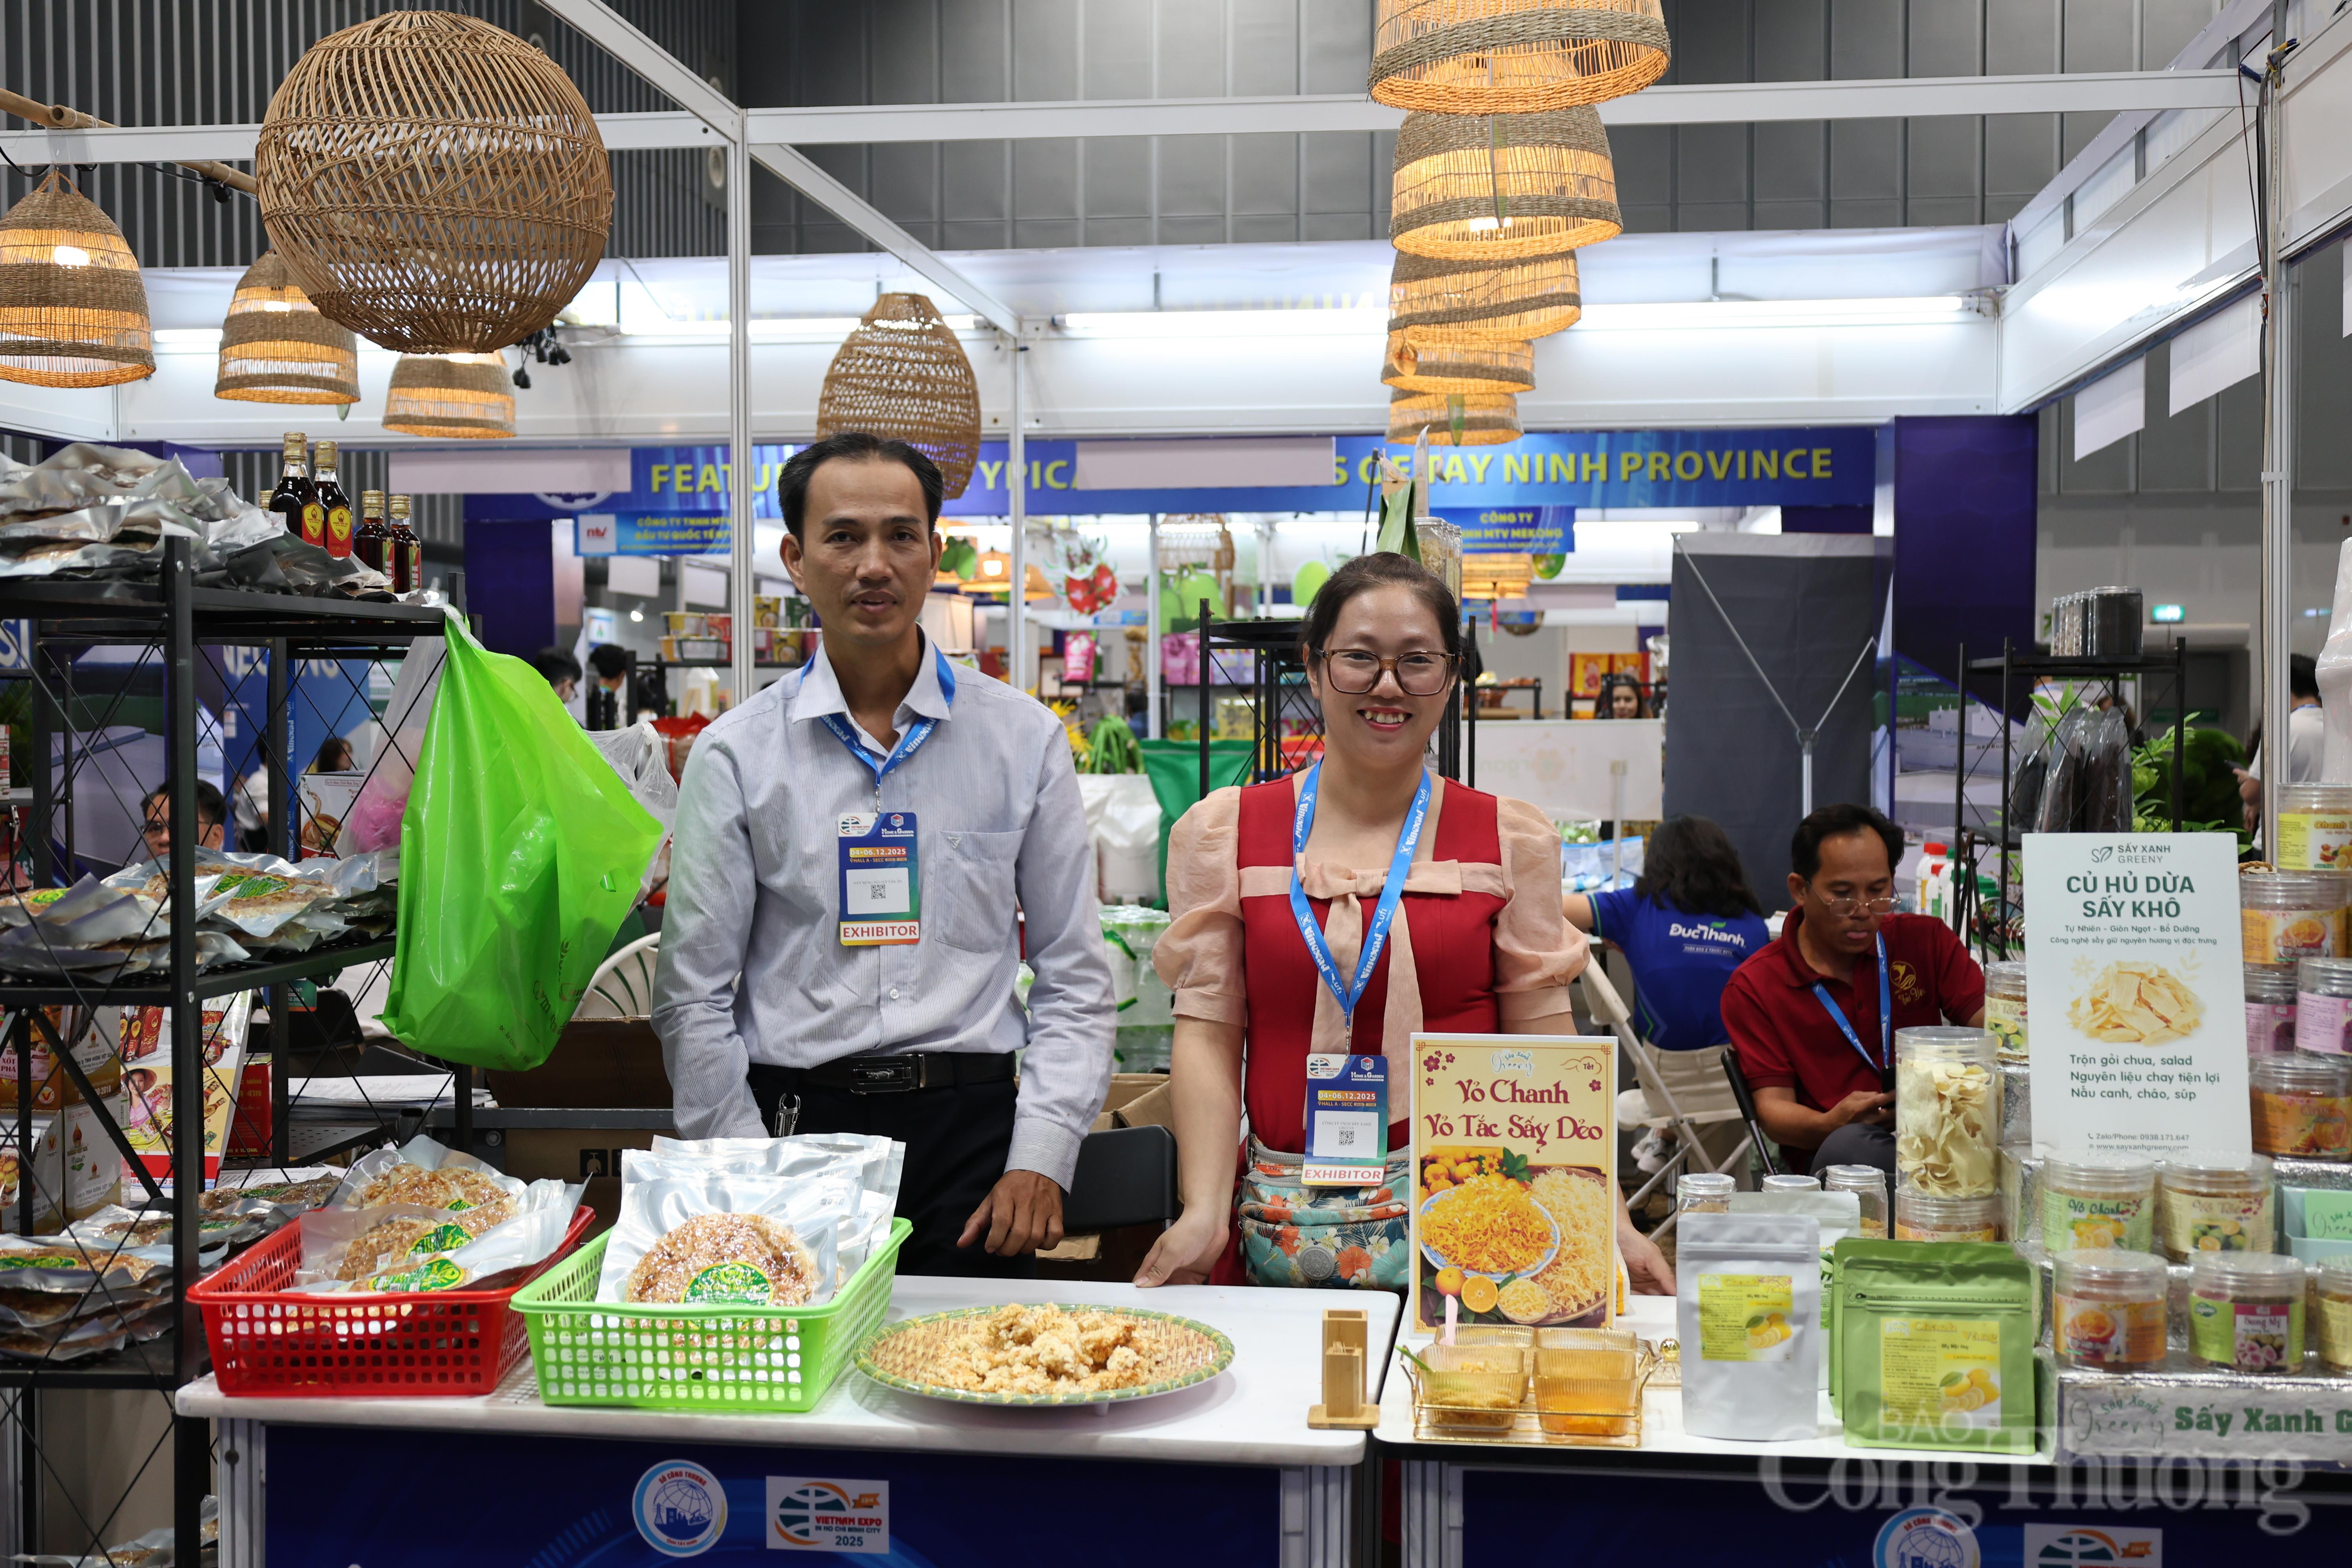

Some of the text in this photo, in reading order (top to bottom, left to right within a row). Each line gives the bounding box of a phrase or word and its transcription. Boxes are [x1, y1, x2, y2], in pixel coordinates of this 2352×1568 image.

[1504, 452, 1607, 483] NINH
[1621, 448, 1833, 481] PROVINCE
[1405, 809, 1424, 846] Vinexad
[2118, 842, 2171, 853] SẤY XANH
[2067, 871, 2195, 893] CỦ HỦ DỪA
[2083, 894, 2181, 918] SẤY KHÔ
[843, 925, 917, 938] EXHIBITOR
[2065, 925, 2075, 934] Tự
[2110, 924, 2129, 933] Giòn
[2132, 925, 2151, 935] Ngọt
[2160, 923, 2171, 933] Bổ
[2173, 924, 2200, 934] Dưỡng
[2050, 936, 2069, 946] Công
[2071, 937, 2089, 946] nghệ
[2120, 937, 2147, 945] nguyên
[2149, 936, 2172, 946] hương
[2198, 937, 2217, 946] trưng
[1304, 925, 1330, 972] Vinexad
[1360, 933, 1383, 978] Vinexad
[2070, 1053, 2192, 1067] Trộn gỏi chua, salad
[2071, 1071, 2220, 1085] Nguyên liệu chay tiện lợi
[1455, 1079, 1570, 1104] Vỏ Chanh
[2071, 1085, 2196, 1101] Nấu canh, cháo, súp
[1424, 1113, 1603, 1153] Vỏ Tắc Sấy Dẻo
[1304, 1169, 1381, 1179] EXHIBITOR
[1913, 1321, 1958, 1332] Chanh
[2174, 1403, 2234, 1437] Sấy
[2243, 1407, 2323, 1433] Xanh
[667, 1471, 683, 1479] CÔNG
[815, 1515, 882, 1527] VIETNAM EXPO
[835, 1535, 863, 1546] 2025
